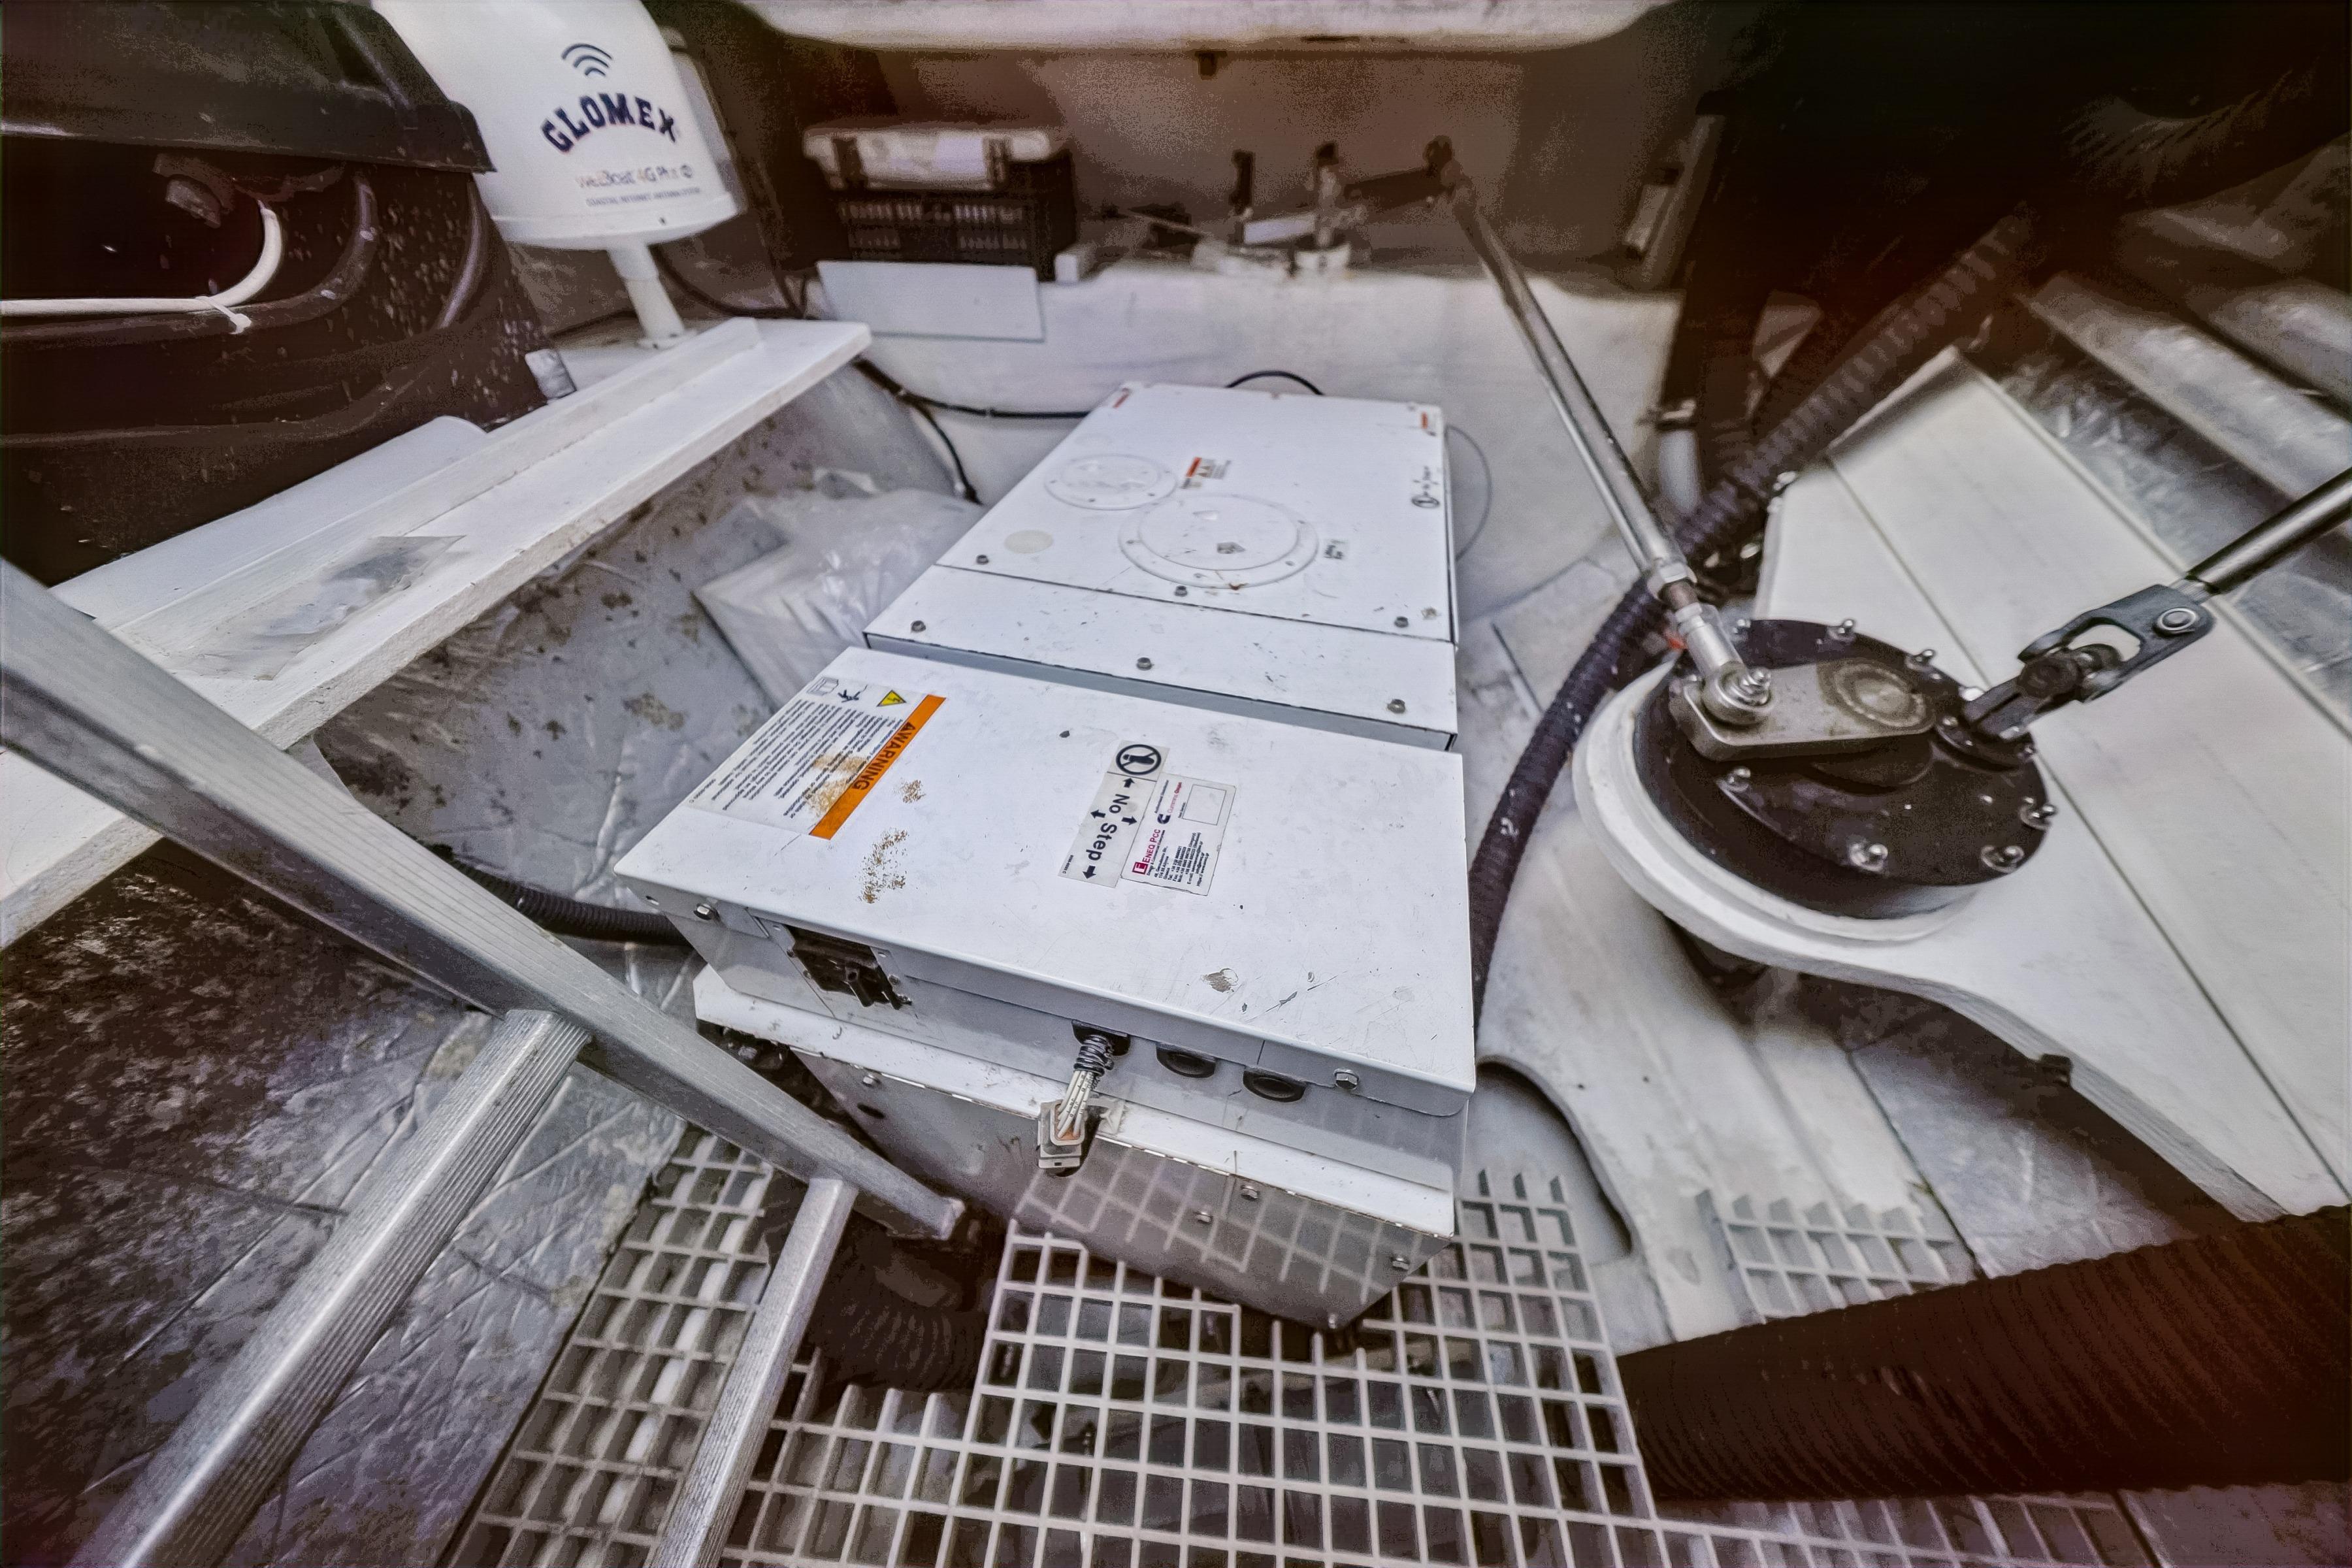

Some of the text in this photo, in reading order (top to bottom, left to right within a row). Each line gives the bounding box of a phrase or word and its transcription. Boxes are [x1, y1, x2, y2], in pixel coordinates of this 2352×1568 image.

[542, 93, 676, 154] GLOMEX
[852, 732, 912, 790] WARNING
[1085, 793, 1130, 861] No Step
[1142, 845, 1155, 862] ENEQ
[1150, 829, 1160, 842] PCC
